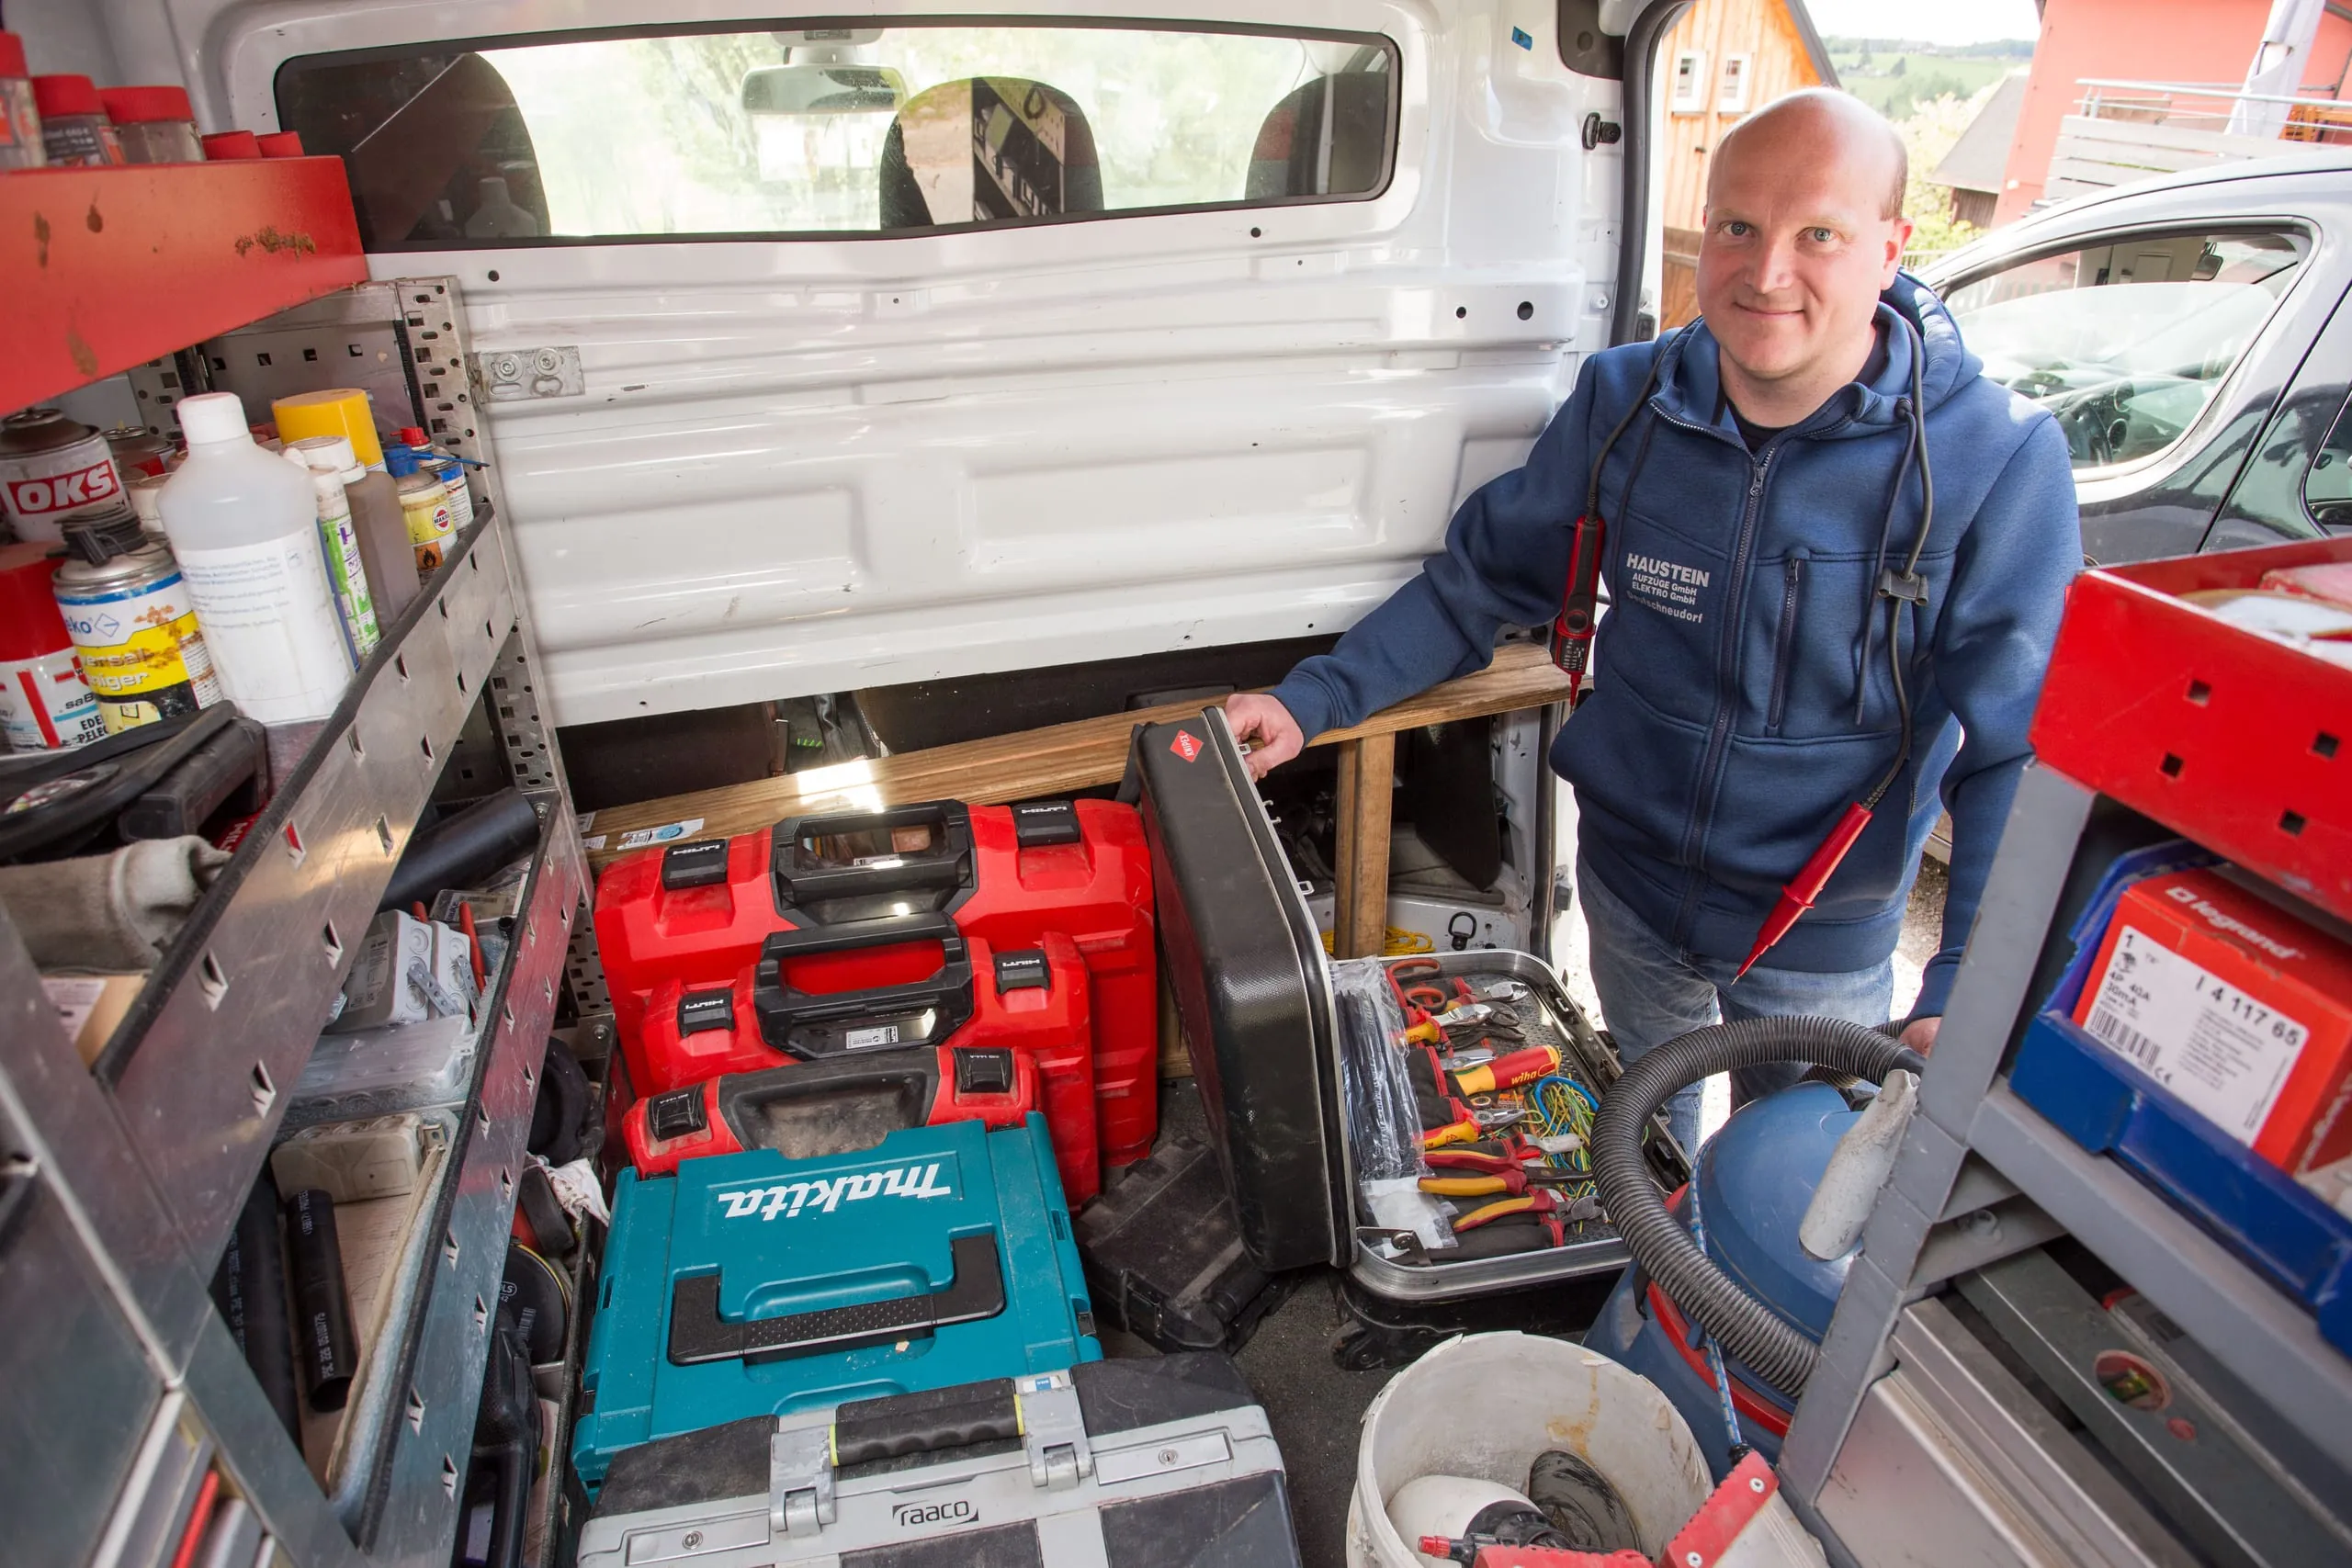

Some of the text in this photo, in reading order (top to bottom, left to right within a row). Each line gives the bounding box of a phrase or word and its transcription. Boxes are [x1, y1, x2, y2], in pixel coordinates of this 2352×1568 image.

[17, 464, 113, 512] OKS
[1626, 553, 1710, 587] HAUSTEIN
[1632, 581, 1696, 605] ELEKTRO GmbH
[1633, 573, 1698, 596] AUFZÜGE GmbH
[1179, 734, 1195, 757] KNIPEX
[1021, 806, 1068, 815] HILTI
[673, 844, 720, 855] HILTI
[2127, 933, 2134, 948] 1
[2189, 899, 2297, 959] legrand
[1001, 959, 1041, 967] HILTI
[684, 998, 724, 1010] HILTI
[2211, 987, 2224, 1002] 4
[2232, 997, 2268, 1026] 117
[2271, 1021, 2300, 1046] 65
[1510, 1070, 1537, 1086] wiha
[499, 1282, 514, 1294] LS
[900, 1500, 969, 1526] raaco
